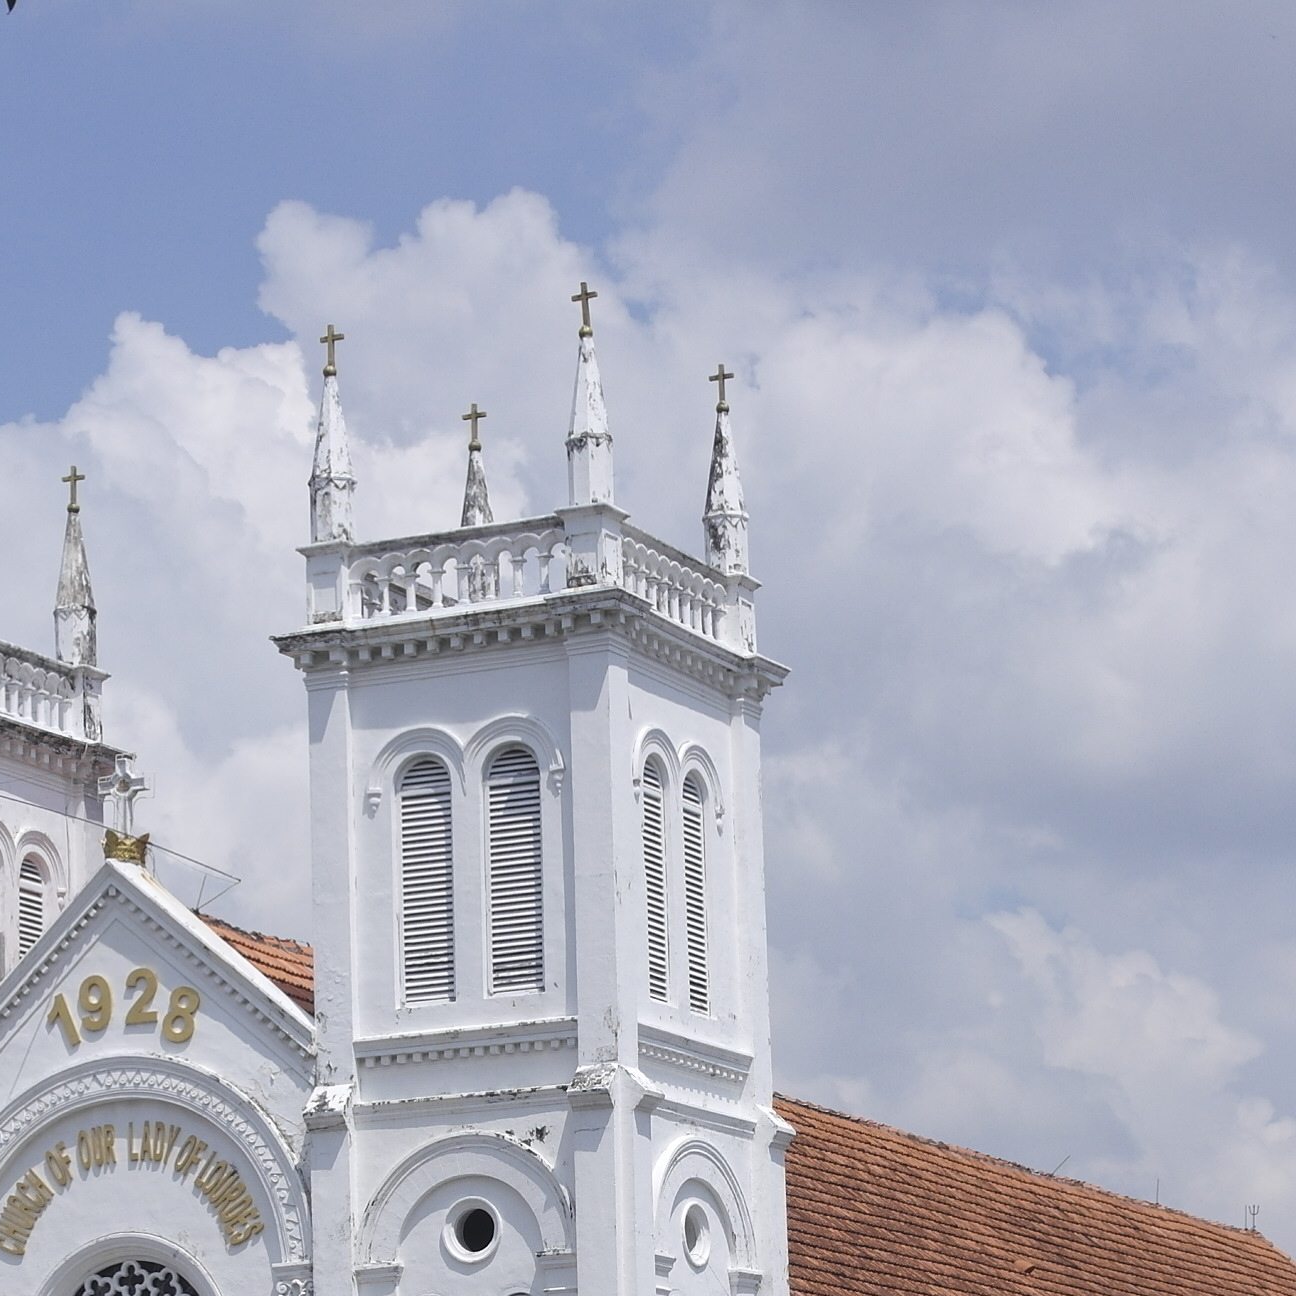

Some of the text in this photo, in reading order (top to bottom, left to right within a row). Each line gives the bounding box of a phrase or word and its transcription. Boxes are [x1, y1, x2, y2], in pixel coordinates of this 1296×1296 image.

[47, 968, 201, 1047] 1928
[45, 1141, 73, 1186] OF
[77, 1124, 116, 1170] OUR
[127, 1120, 181, 1165] LADY
[174, 1134, 209, 1176] OF
[194, 1151, 264, 1246] LOURDES
